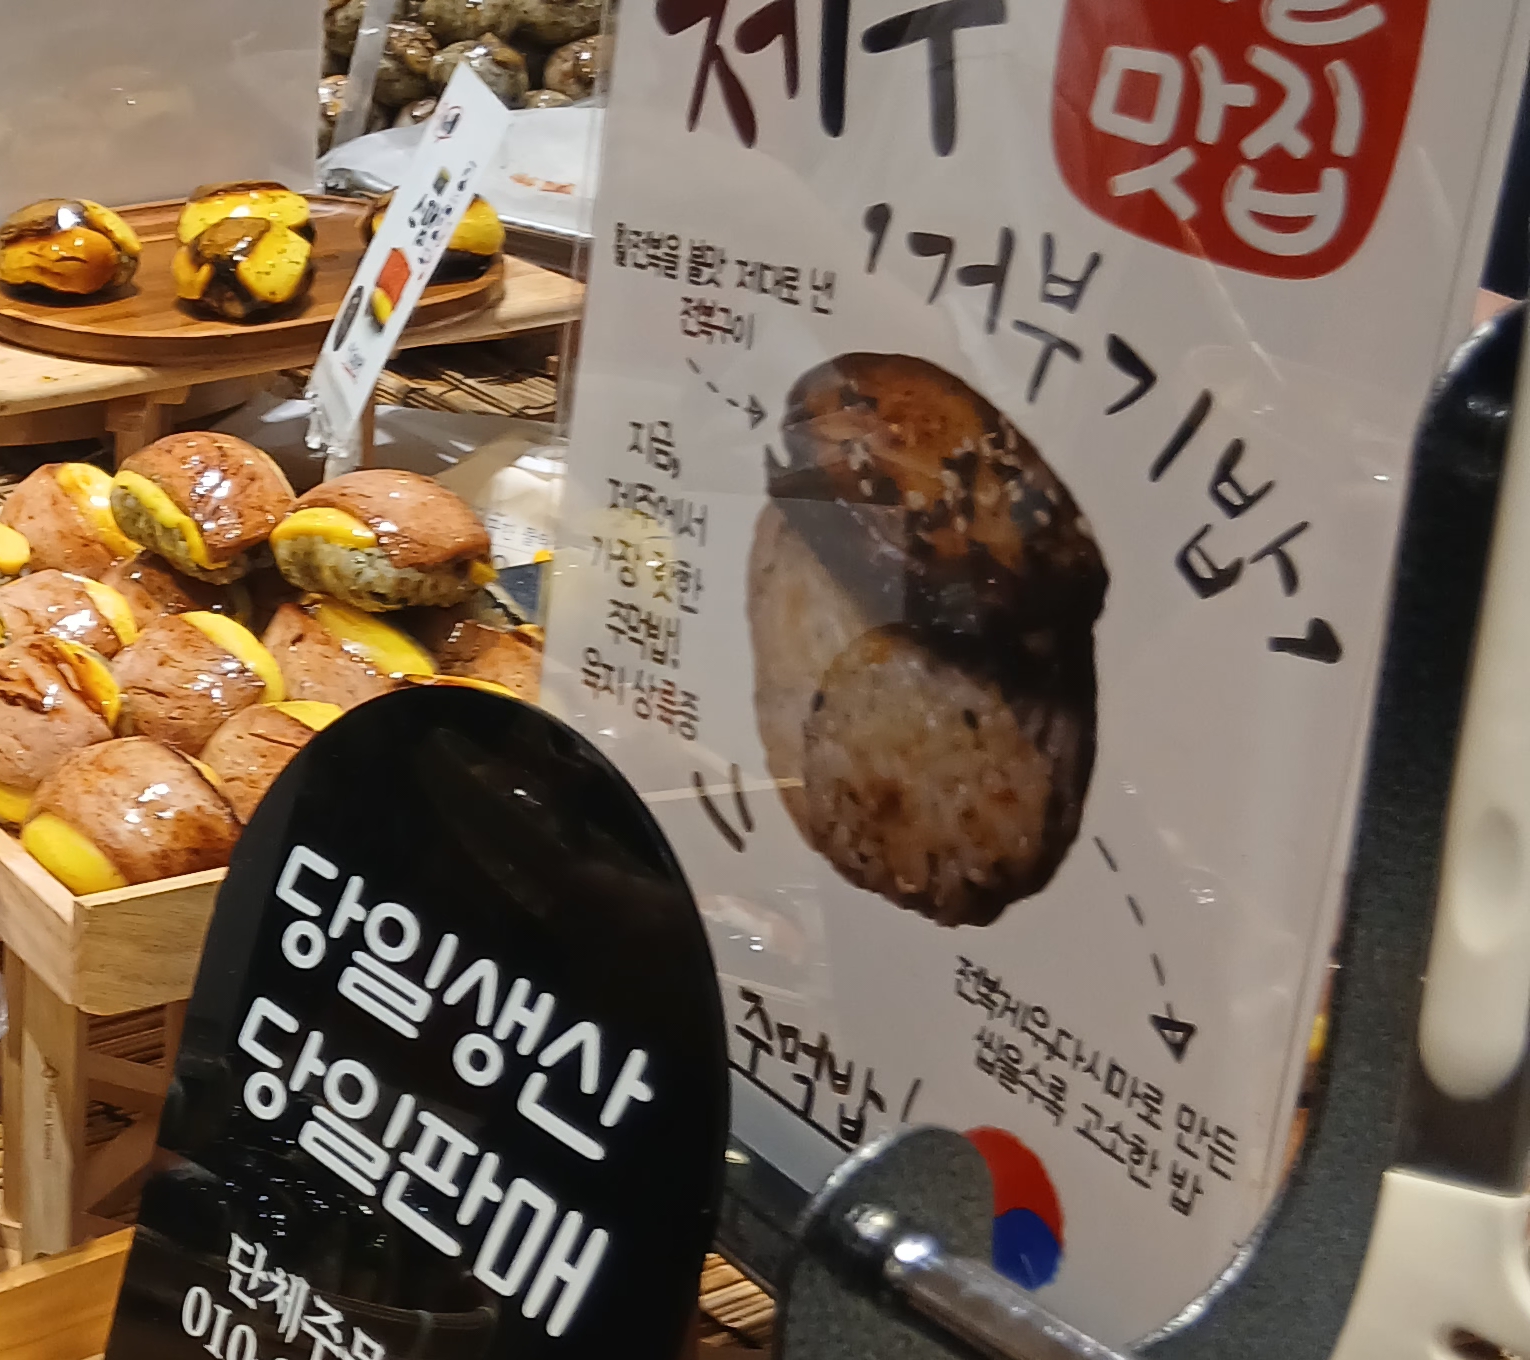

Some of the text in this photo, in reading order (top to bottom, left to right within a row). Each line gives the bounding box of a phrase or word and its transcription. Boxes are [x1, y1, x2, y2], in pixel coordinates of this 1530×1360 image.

[1088, 42, 1364, 257] 맛집
[275, 844, 655, 1162] 당일생산
[734, 984, 888, 1146] 주먹밥
[237, 996, 611, 1338] 당일판매
[1169, 1159, 1205, 1217] 밥
